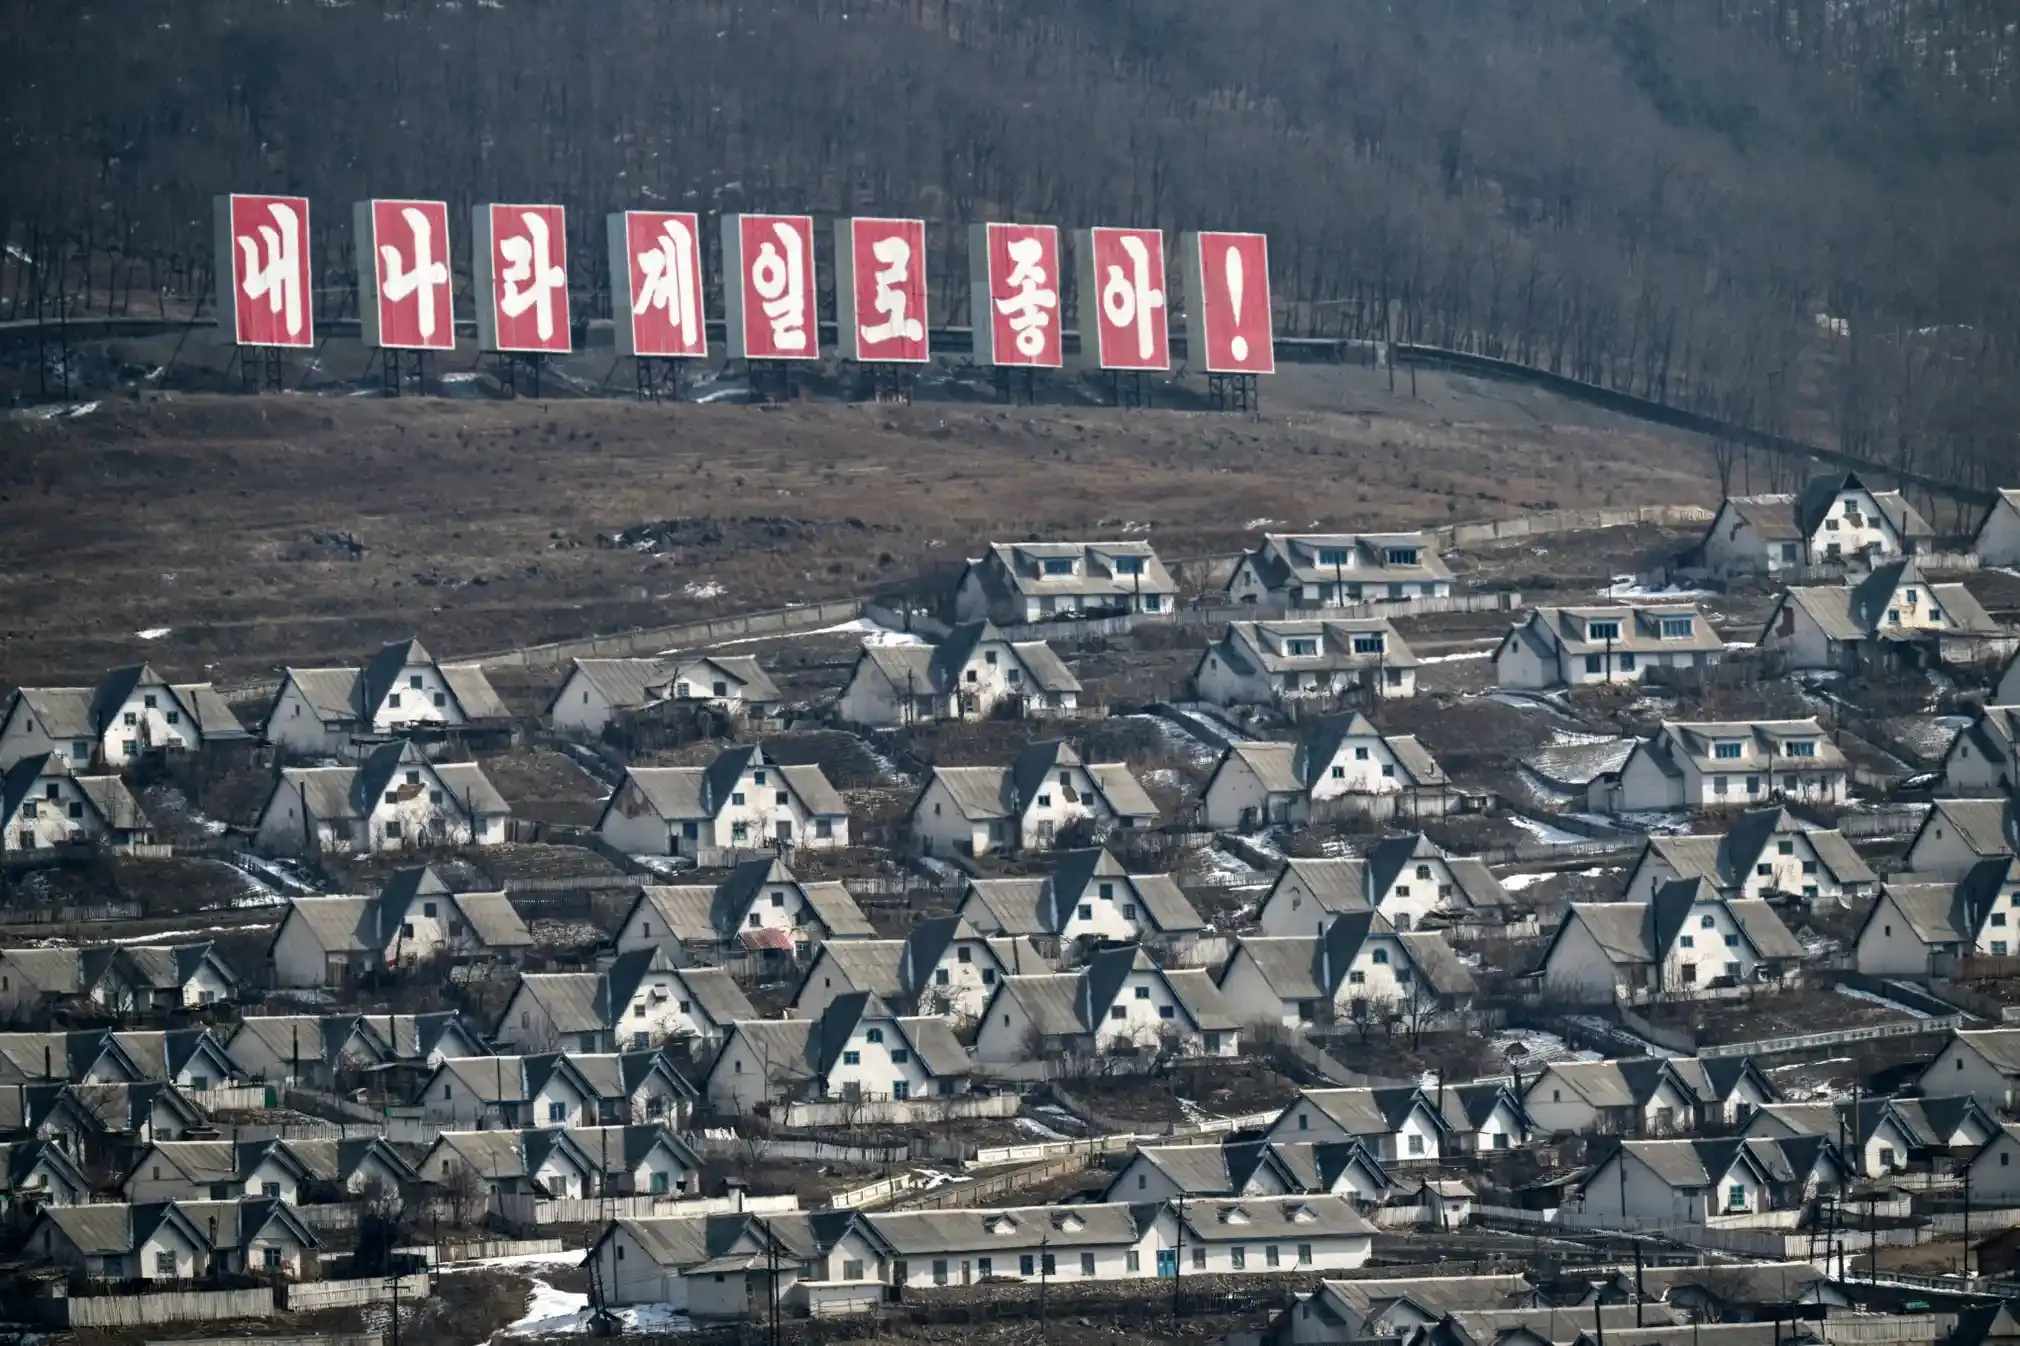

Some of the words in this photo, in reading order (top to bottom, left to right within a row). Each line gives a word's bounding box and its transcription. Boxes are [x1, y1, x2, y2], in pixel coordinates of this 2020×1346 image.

[237, 203, 302, 337] 내
[381, 207, 565, 341] 나라
[632, 219, 923, 350] 제일로
[996, 236, 1248, 361] 좋아!
